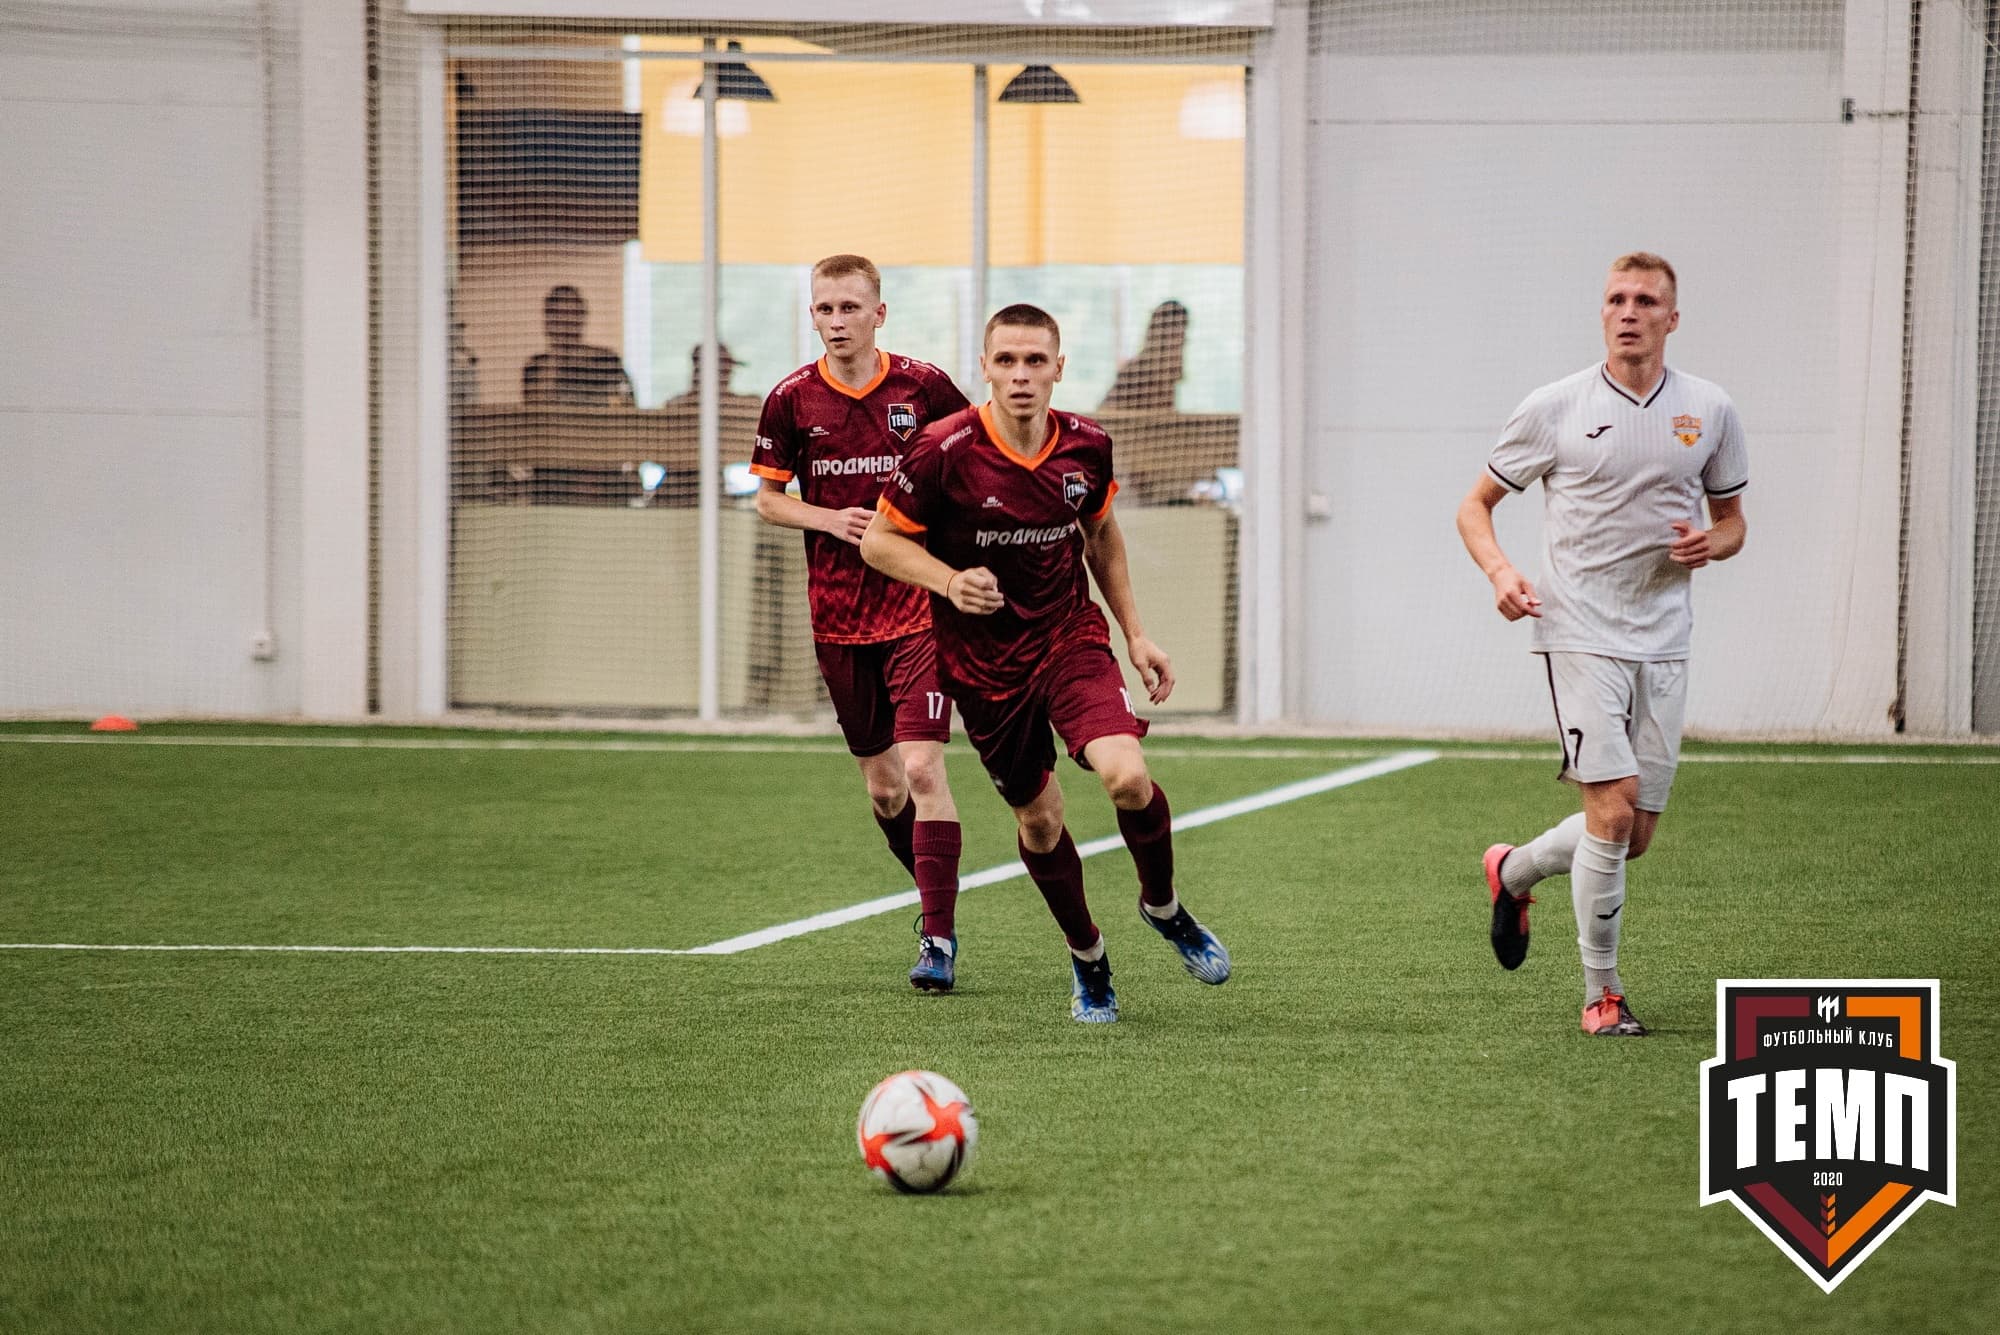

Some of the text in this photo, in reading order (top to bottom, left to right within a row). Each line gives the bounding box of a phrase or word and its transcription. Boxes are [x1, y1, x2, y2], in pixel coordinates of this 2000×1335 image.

[891, 413, 914, 428] ТЕМП
[925, 691, 944, 720] 17
[1567, 727, 1584, 769] 7
